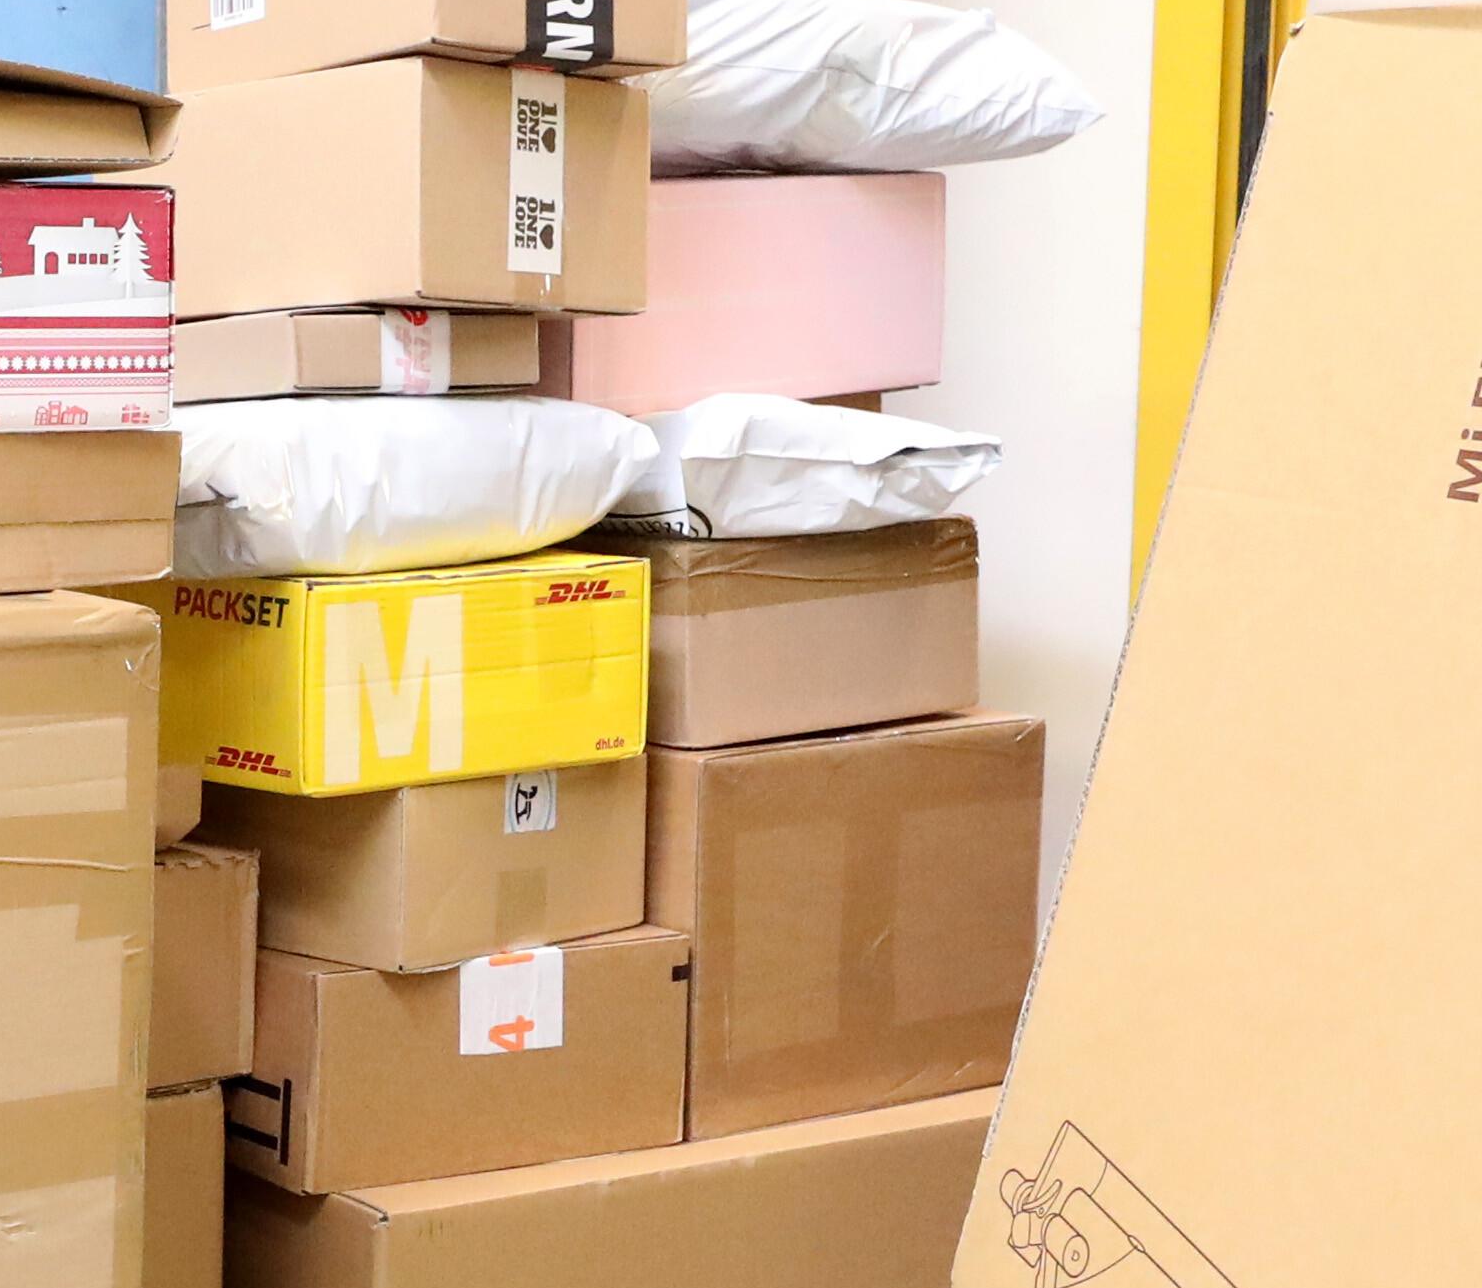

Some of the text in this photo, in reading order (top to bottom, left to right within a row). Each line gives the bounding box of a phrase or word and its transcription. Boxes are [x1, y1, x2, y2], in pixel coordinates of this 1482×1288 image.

[517, 97, 529, 152] LOVE
[528, 99, 541, 154] ONE
[514, 194, 527, 249] LOVE
[526, 196, 539, 250] ONE
[173, 585, 290, 629] PACKSET
[547, 579, 614, 604] DHL
[324, 592, 464, 786] M
[216, 745, 281, 777] DHL
[595, 737, 626, 751] dhl.de
